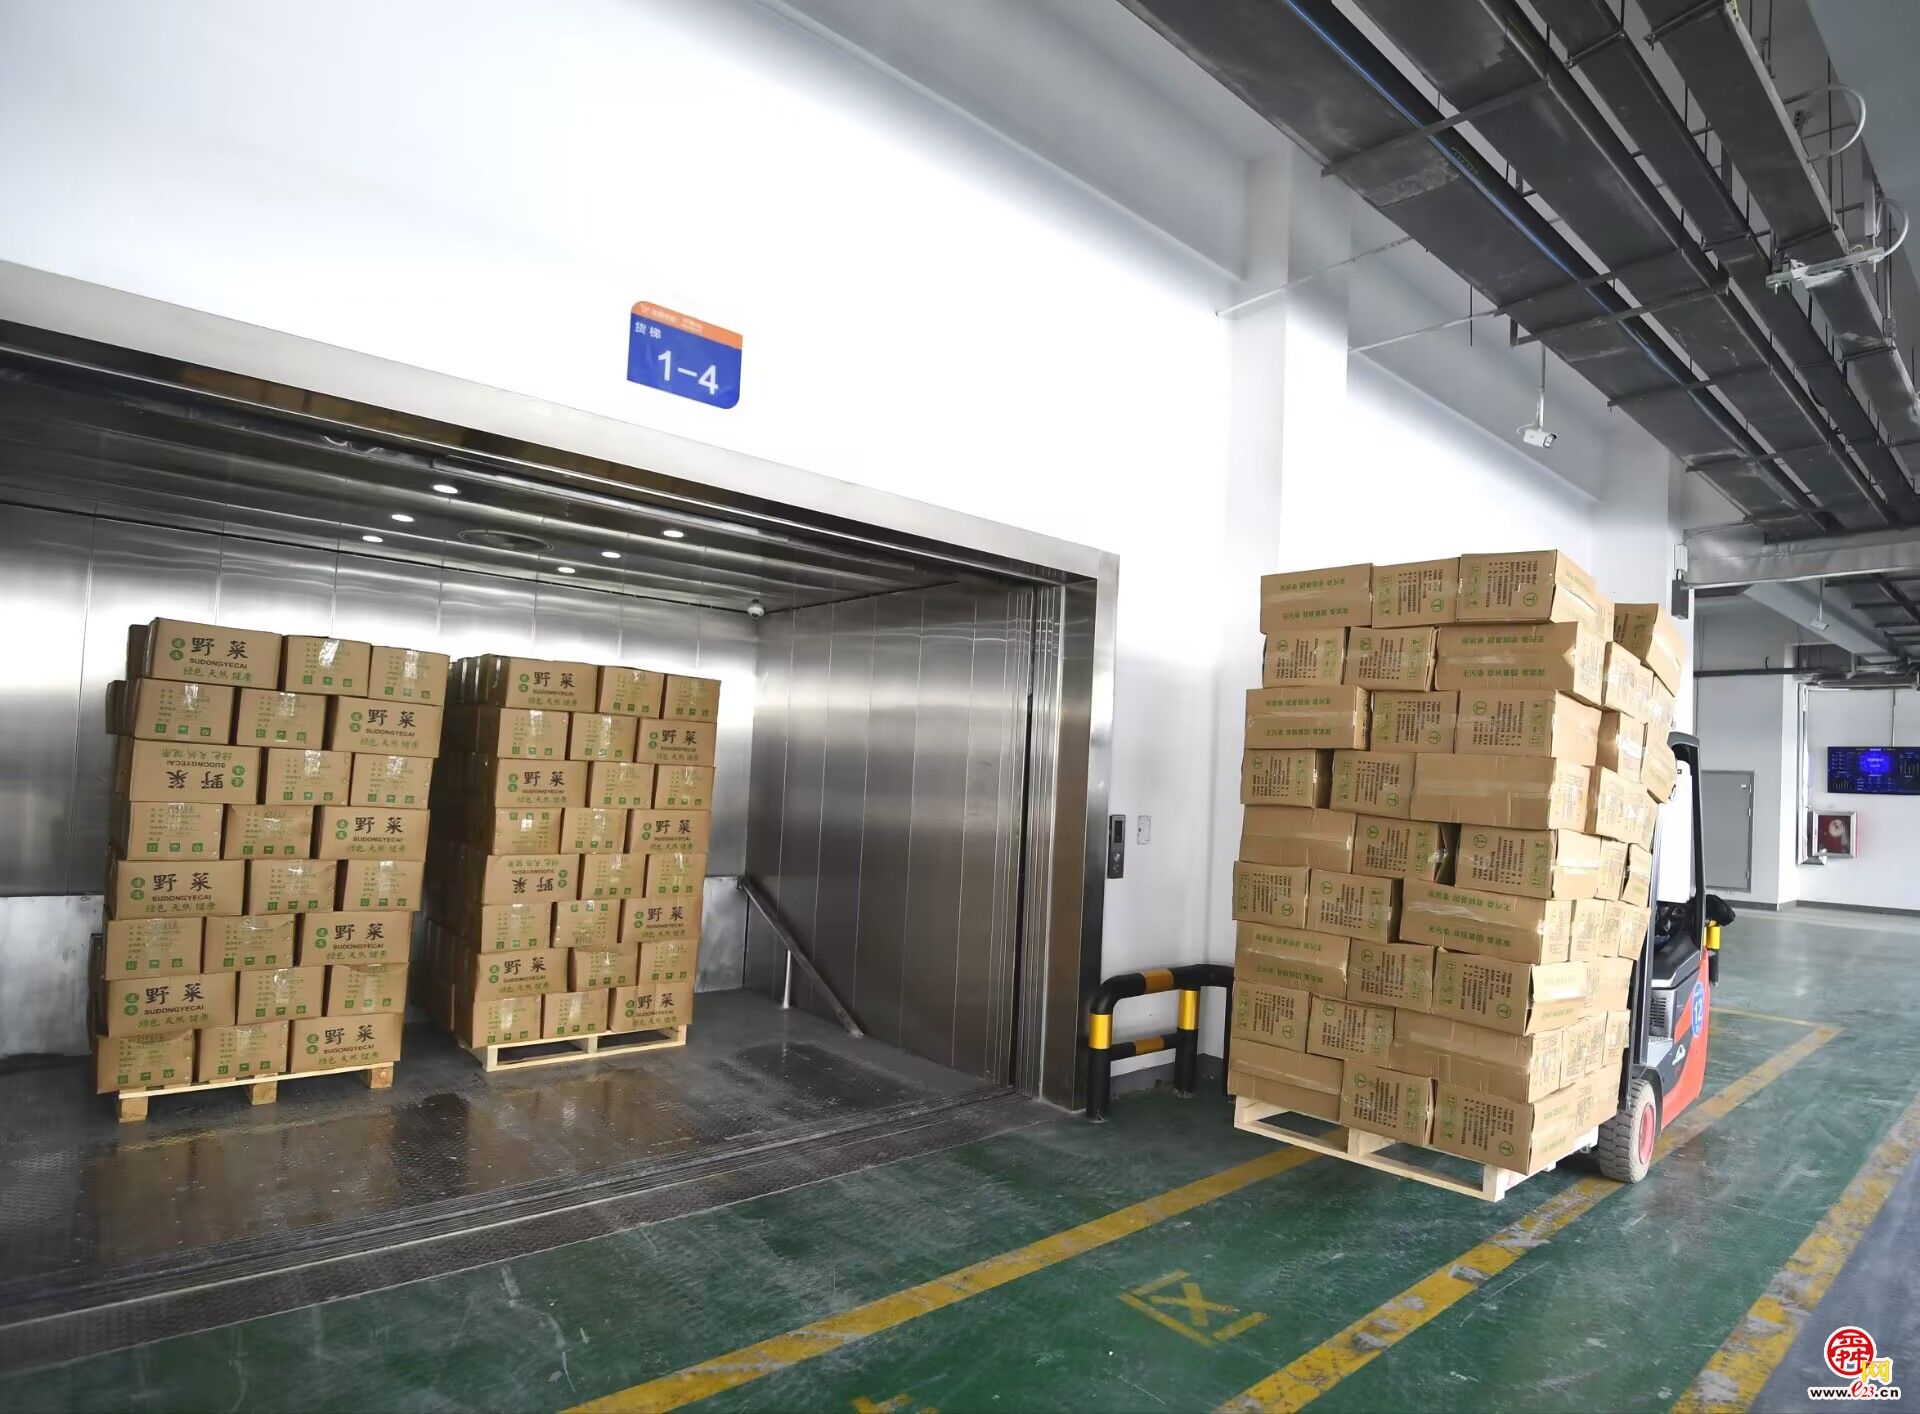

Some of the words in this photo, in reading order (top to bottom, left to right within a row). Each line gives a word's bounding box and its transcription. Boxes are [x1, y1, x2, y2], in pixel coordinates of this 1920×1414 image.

[190, 637, 249, 659] 野菜
[189, 658, 248, 669] SUDONGYECAI
[533, 671, 575, 689] 野菜
[367, 708, 417, 728] 野菜
[661, 729, 697, 746] 野菜
[166, 760, 226, 768] SUDONGYECAI
[165, 769, 225, 789] 野菜
[523, 771, 566, 787] 野菜
[354, 816, 404, 834] 野菜
[655, 819, 691, 834] 野菜
[153, 872, 212, 892] 野菜
[511, 876, 555, 894] 野菜
[647, 906, 684, 922] 野菜
[334, 922, 385, 941] 野菜
[503, 957, 547, 975] 野菜
[145, 982, 205, 1005] 野菜
[638, 992, 675, 1010] 野菜
[143, 1004, 204, 1015] SUDONGYECAI
[324, 1024, 375, 1045] 野菜
